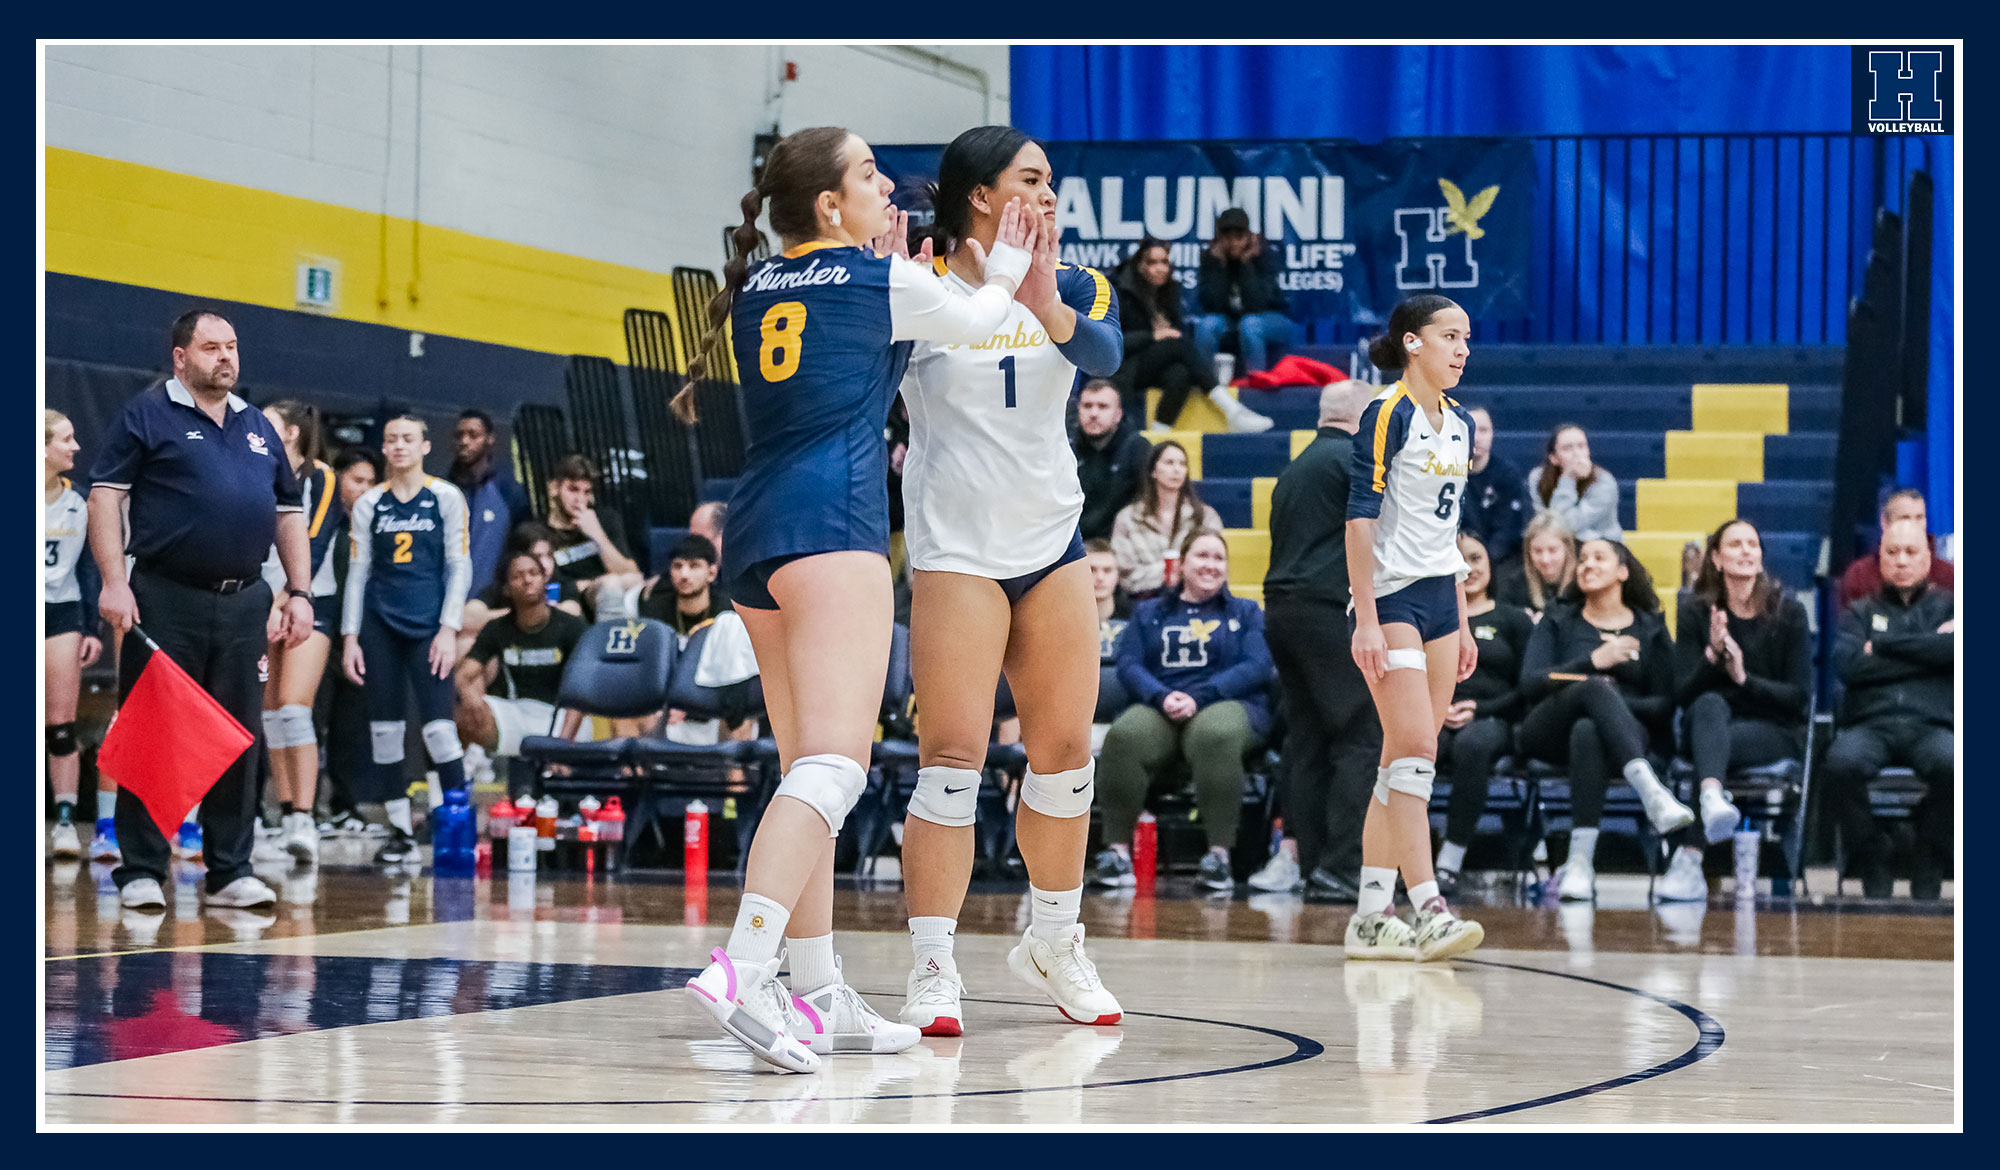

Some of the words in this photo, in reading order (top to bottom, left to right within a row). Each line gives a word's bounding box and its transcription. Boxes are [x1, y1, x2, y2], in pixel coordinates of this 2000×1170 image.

[1055, 176, 1345, 240] ALUMNI
[1059, 242, 1121, 268] AWK
[742, 258, 851, 292] Humber
[1279, 271, 1343, 293] LEGES)
[759, 301, 807, 383] 8
[948, 321, 1054, 350] umbe
[999, 355, 1016, 408] 1
[1434, 482, 1456, 520] 6
[45, 540, 60, 567] 3
[393, 532, 413, 563] 2
